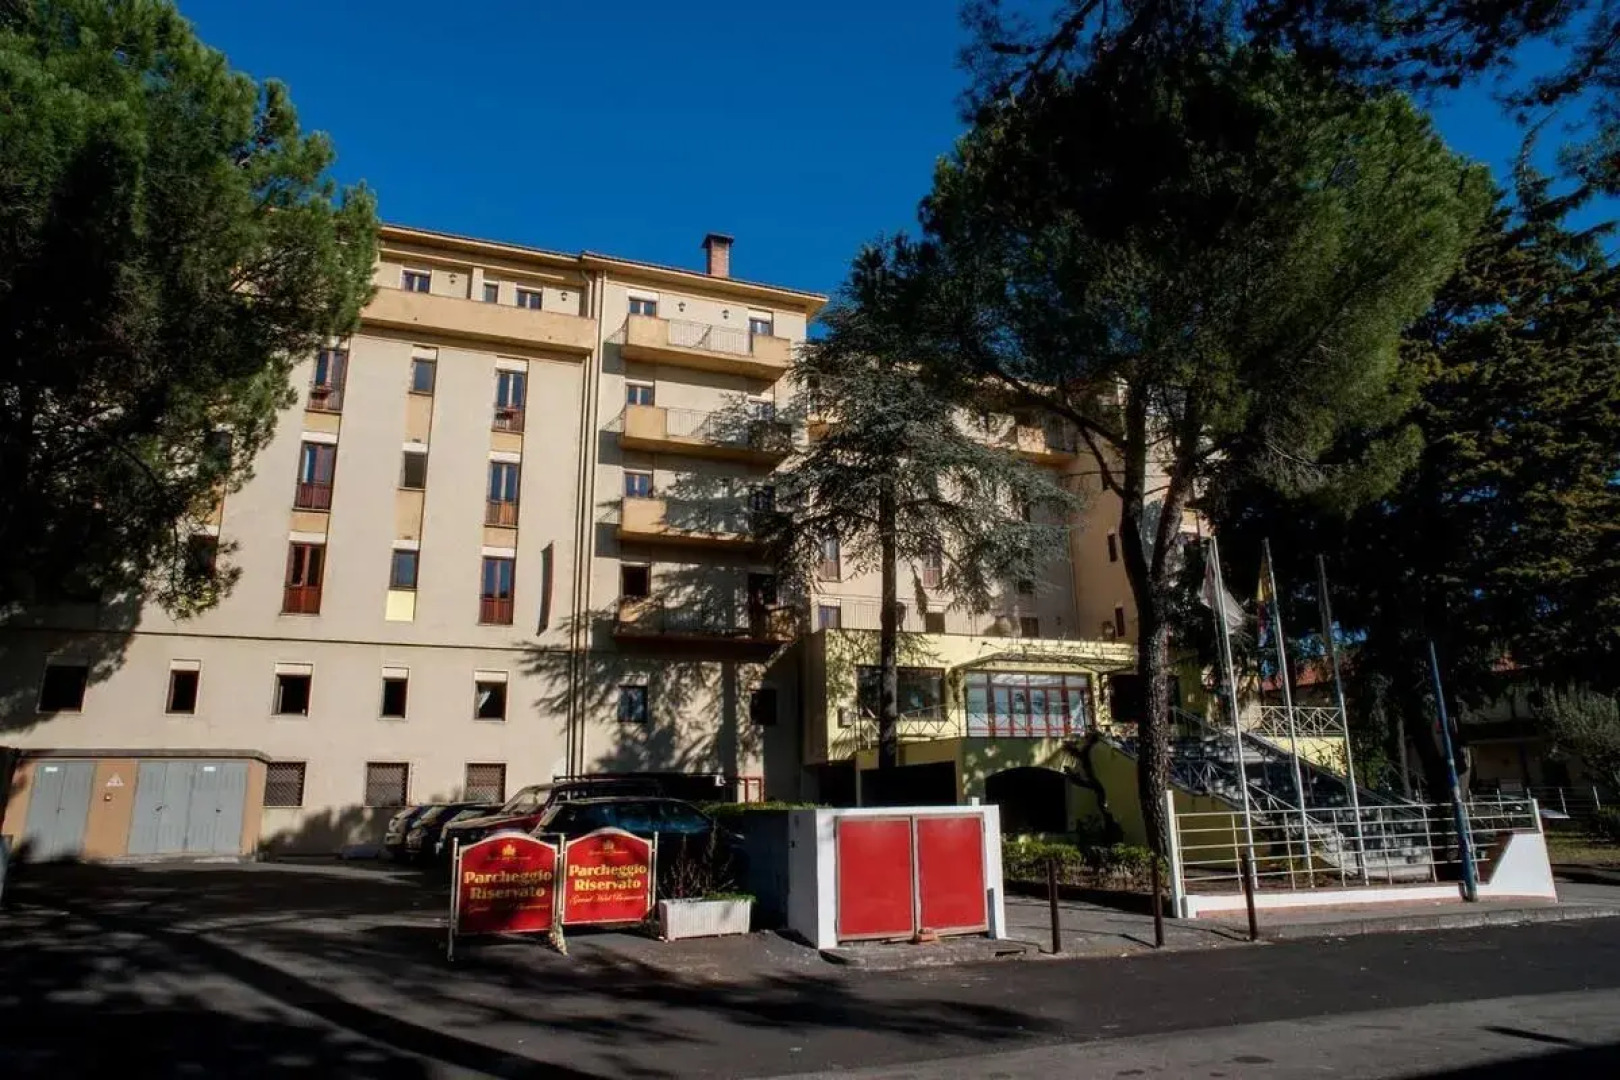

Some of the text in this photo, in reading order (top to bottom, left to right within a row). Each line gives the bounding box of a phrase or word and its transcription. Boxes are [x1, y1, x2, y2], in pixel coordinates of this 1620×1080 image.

[464, 870, 552, 885] Parcheggio
[568, 864, 647, 878] Parcheggio
[574, 879, 641, 892] Riservato
[470, 886, 545, 899] Riservato
